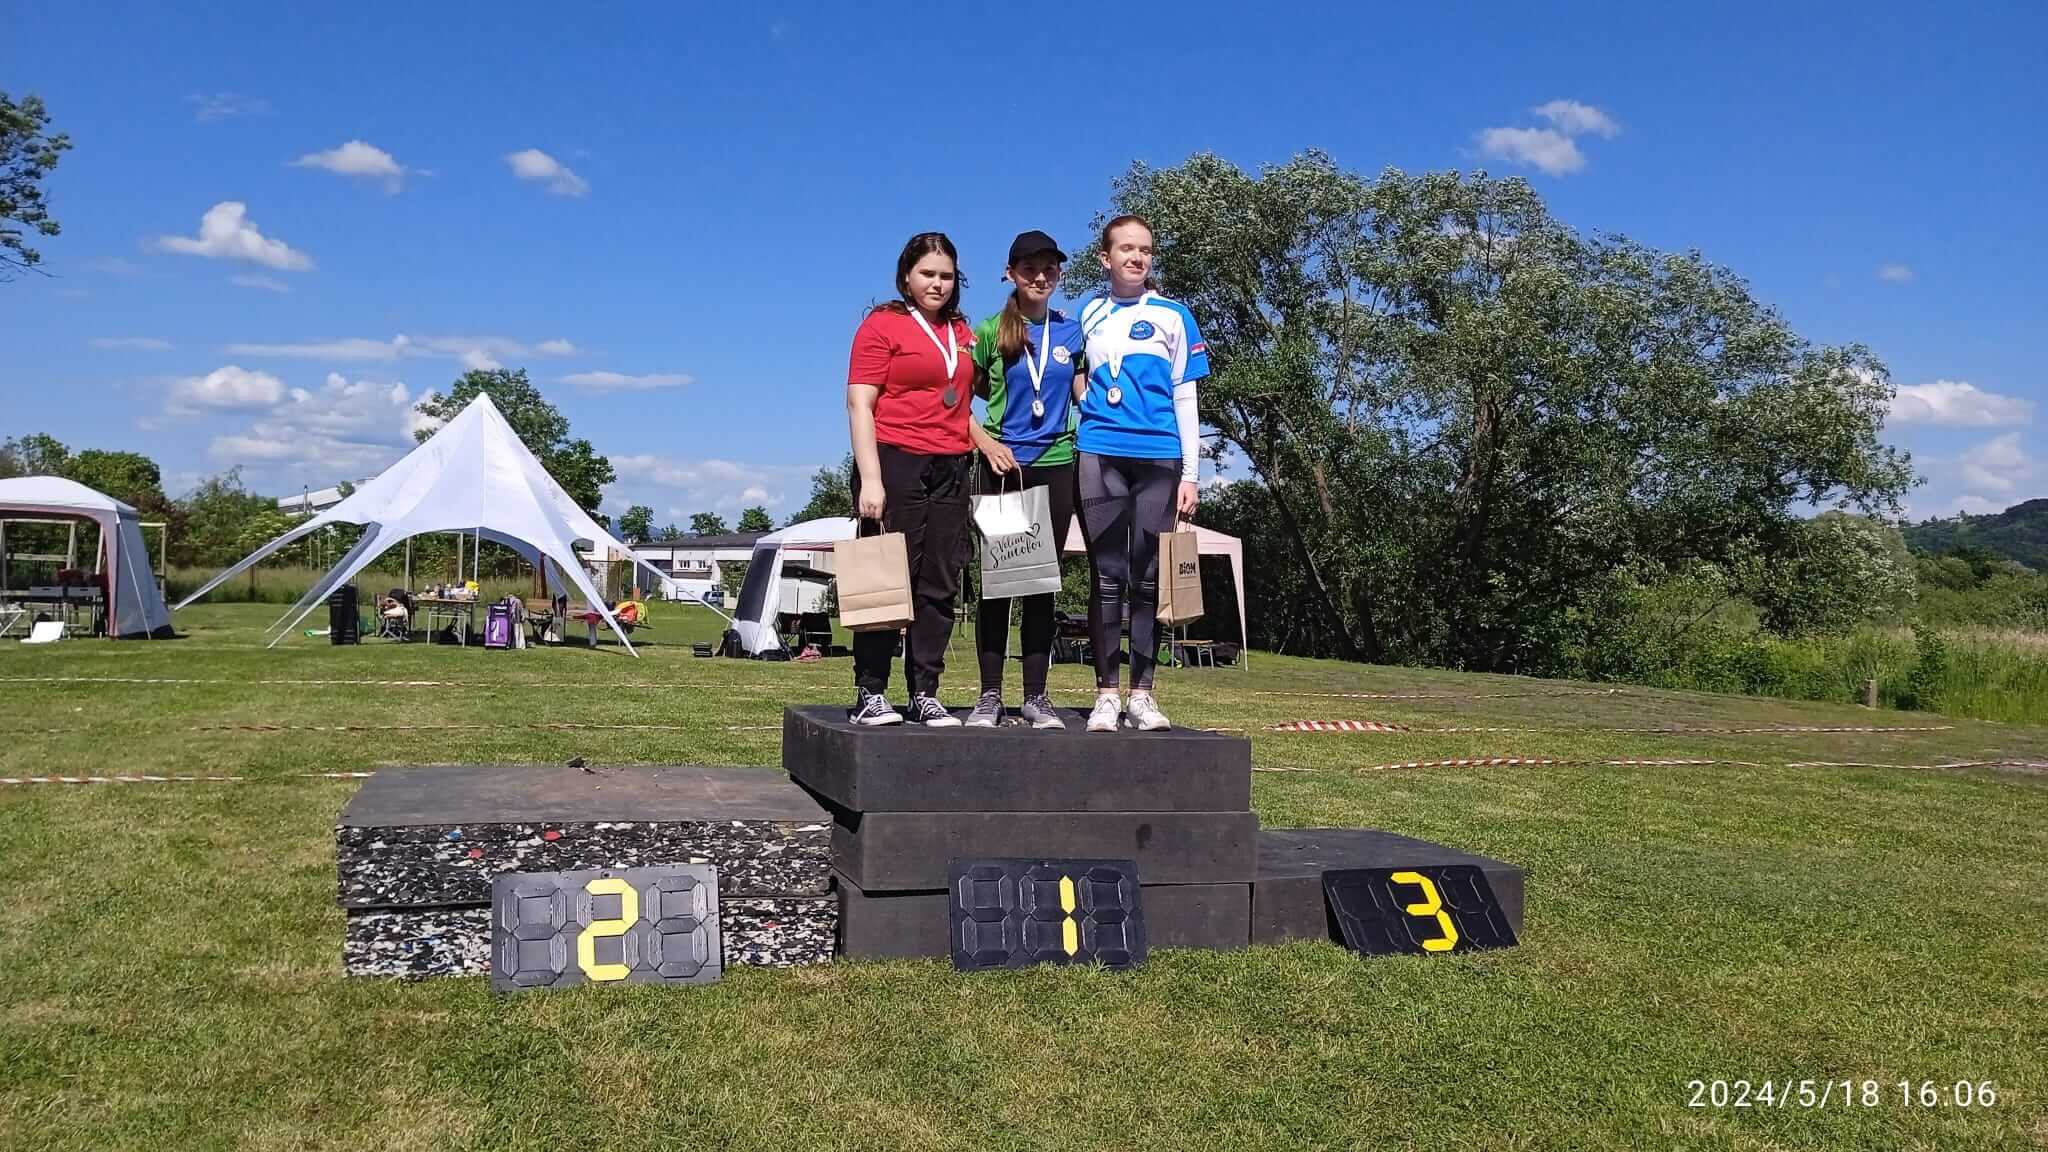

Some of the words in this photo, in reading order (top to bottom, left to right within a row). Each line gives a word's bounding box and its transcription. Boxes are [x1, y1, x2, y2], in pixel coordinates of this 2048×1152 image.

[577, 878, 640, 982] 2
[1059, 874, 1078, 957] 1
[1390, 871, 1459, 952] 3
